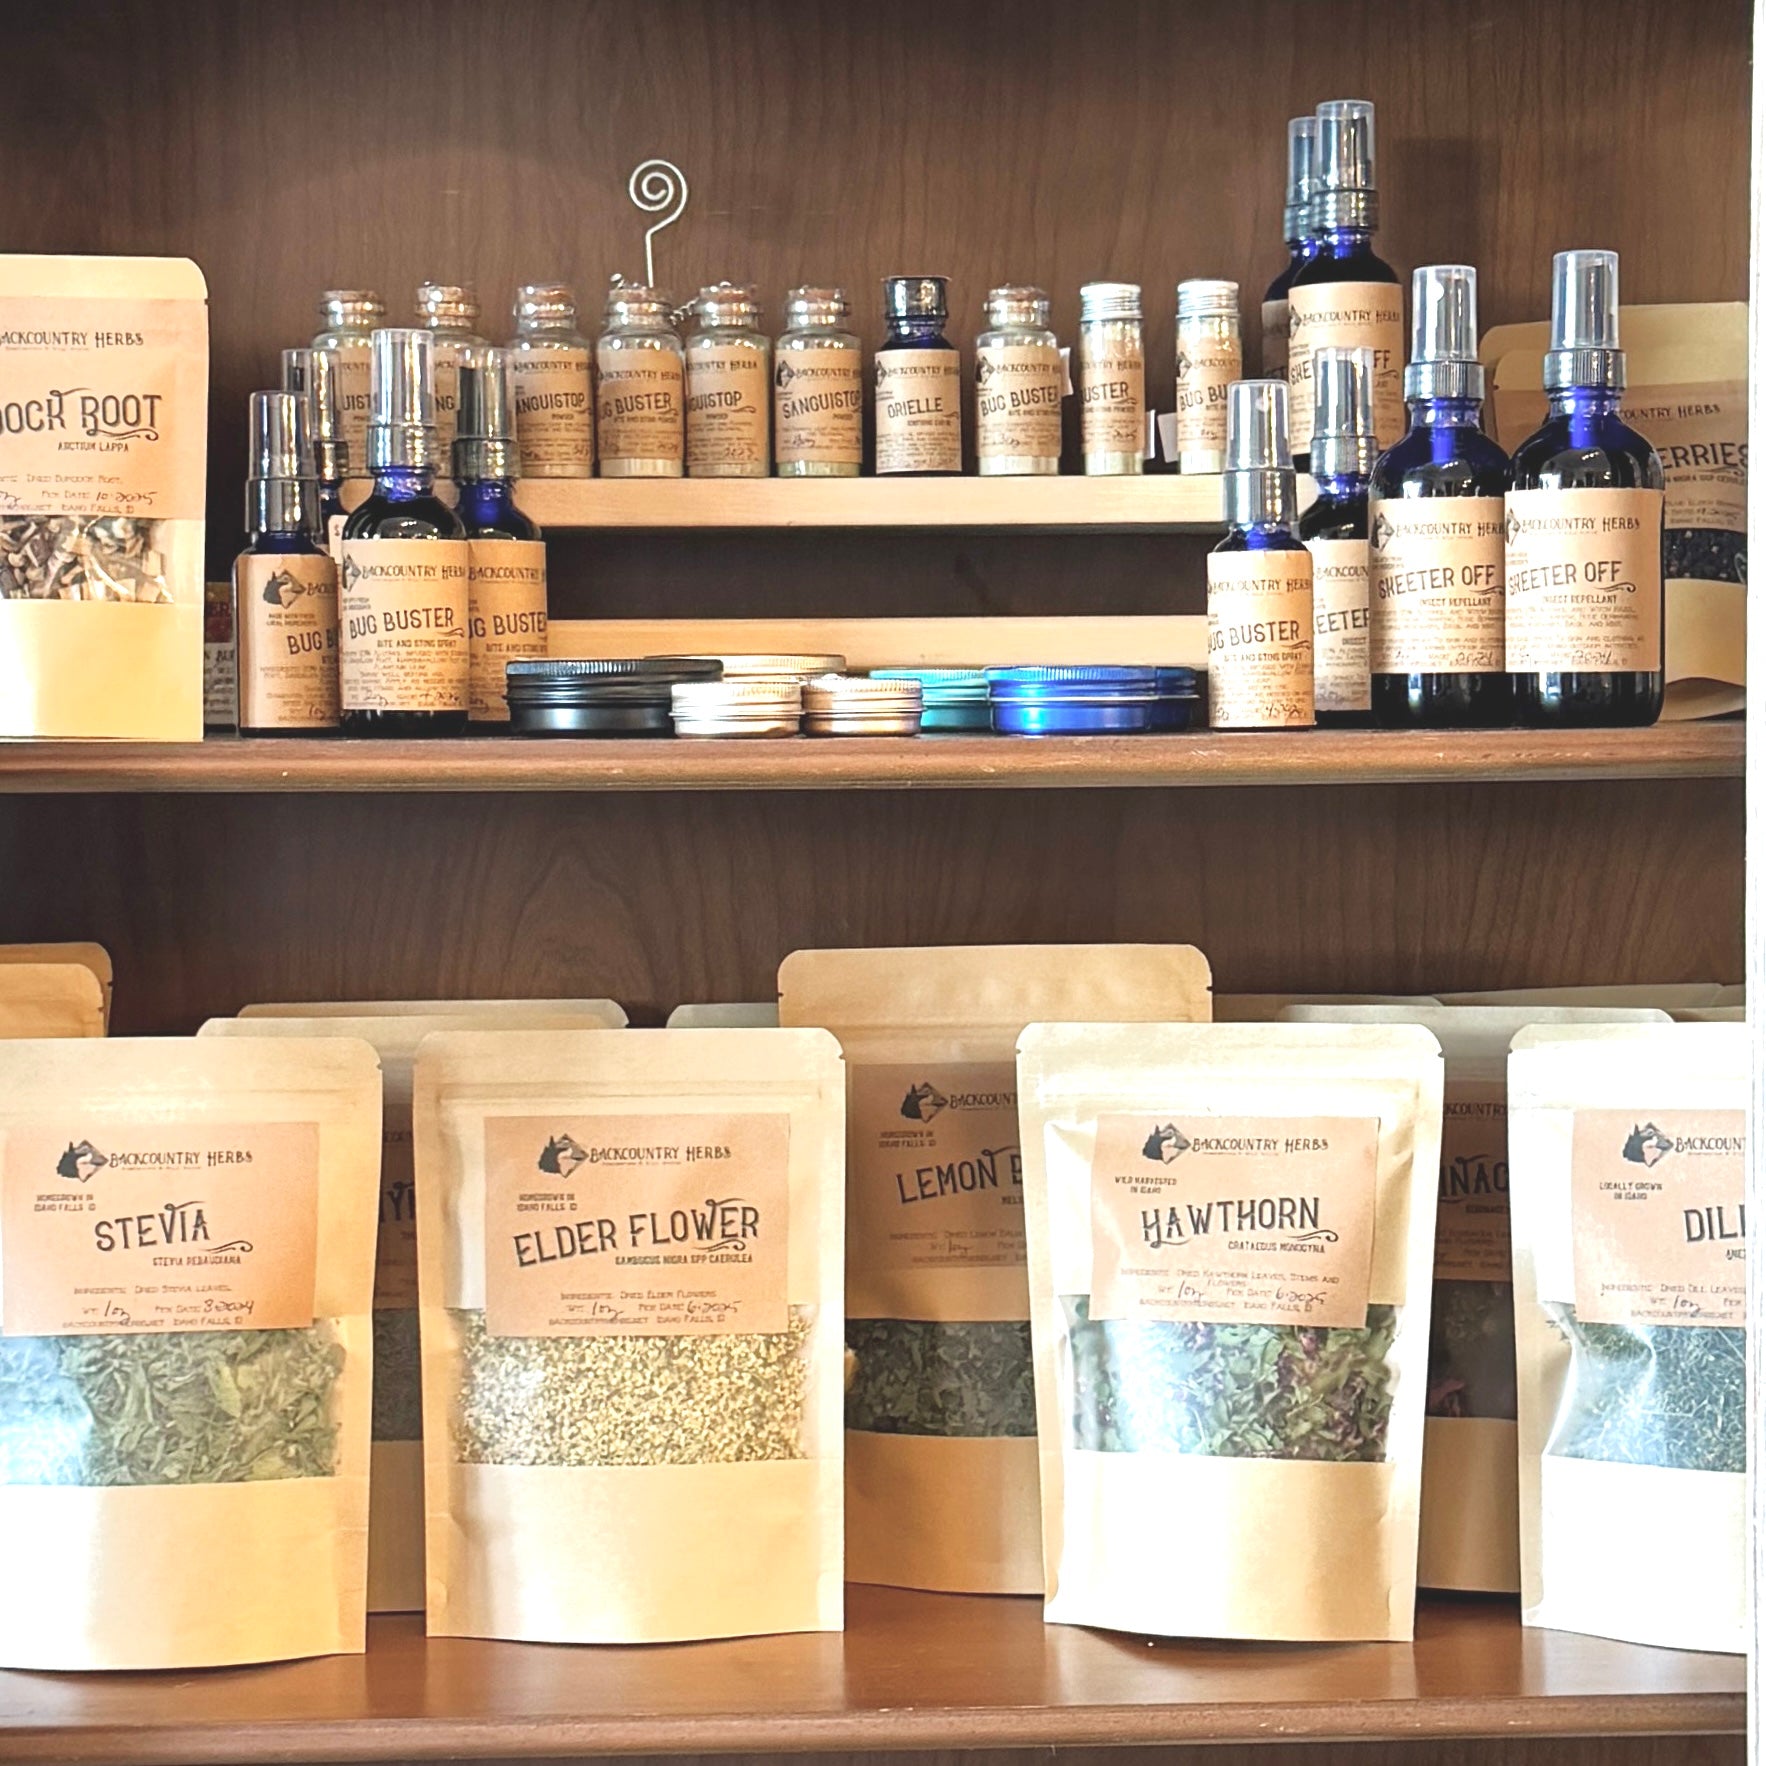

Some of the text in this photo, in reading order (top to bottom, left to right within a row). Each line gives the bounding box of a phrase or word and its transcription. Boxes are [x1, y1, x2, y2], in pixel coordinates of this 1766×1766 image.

[0, 332, 144, 348] ACKCOUNTRY HERBS
[1290, 360, 1312, 386] SKE
[1374, 350, 1391, 369] FF
[516, 393, 585, 416] ANGUISTOP
[615, 392, 672, 415] BUSTER
[887, 397, 943, 419] ORIELLE
[980, 386, 1058, 417] BUG BUSTE
[1180, 390, 1202, 411] BUG
[1678, 404, 1720, 418] HERBS
[0, 389, 162, 440] OCK ROOT
[100, 442, 129, 452] LAPPA
[1602, 517, 1640, 532] HERBS
[362, 565, 438, 579] BACKCOUNTRY
[1316, 566, 1369, 580] BACKCOUN
[1378, 565, 1496, 599] SKEETER OFF
[1508, 561, 1622, 596] SKEETER OFF
[350, 607, 454, 639] BUG BUSTER
[493, 612, 546, 635] BUSTE
[1229, 620, 1300, 646] BUSTER
[287, 631, 322, 655] BUG
[590, 1146, 732, 1163] BACKCOUNTRY HERBS
[1192, 1138, 1329, 1153] BACKCOUNTRY HERBS
[109, 1151, 252, 1168] BACKCOUNTRY HERBS
[896, 1150, 999, 1204] LEMON
[1599, 1182, 1633, 1190] LOCALLY
[95, 1202, 211, 1251] STEVIA
[513, 1201, 760, 1267] ELDER FLOWER
[1141, 1197, 1320, 1248] HAWTHORN
[153, 1257, 183, 1267] STEVIA
[663, 1255, 688, 1265] NIGRA
